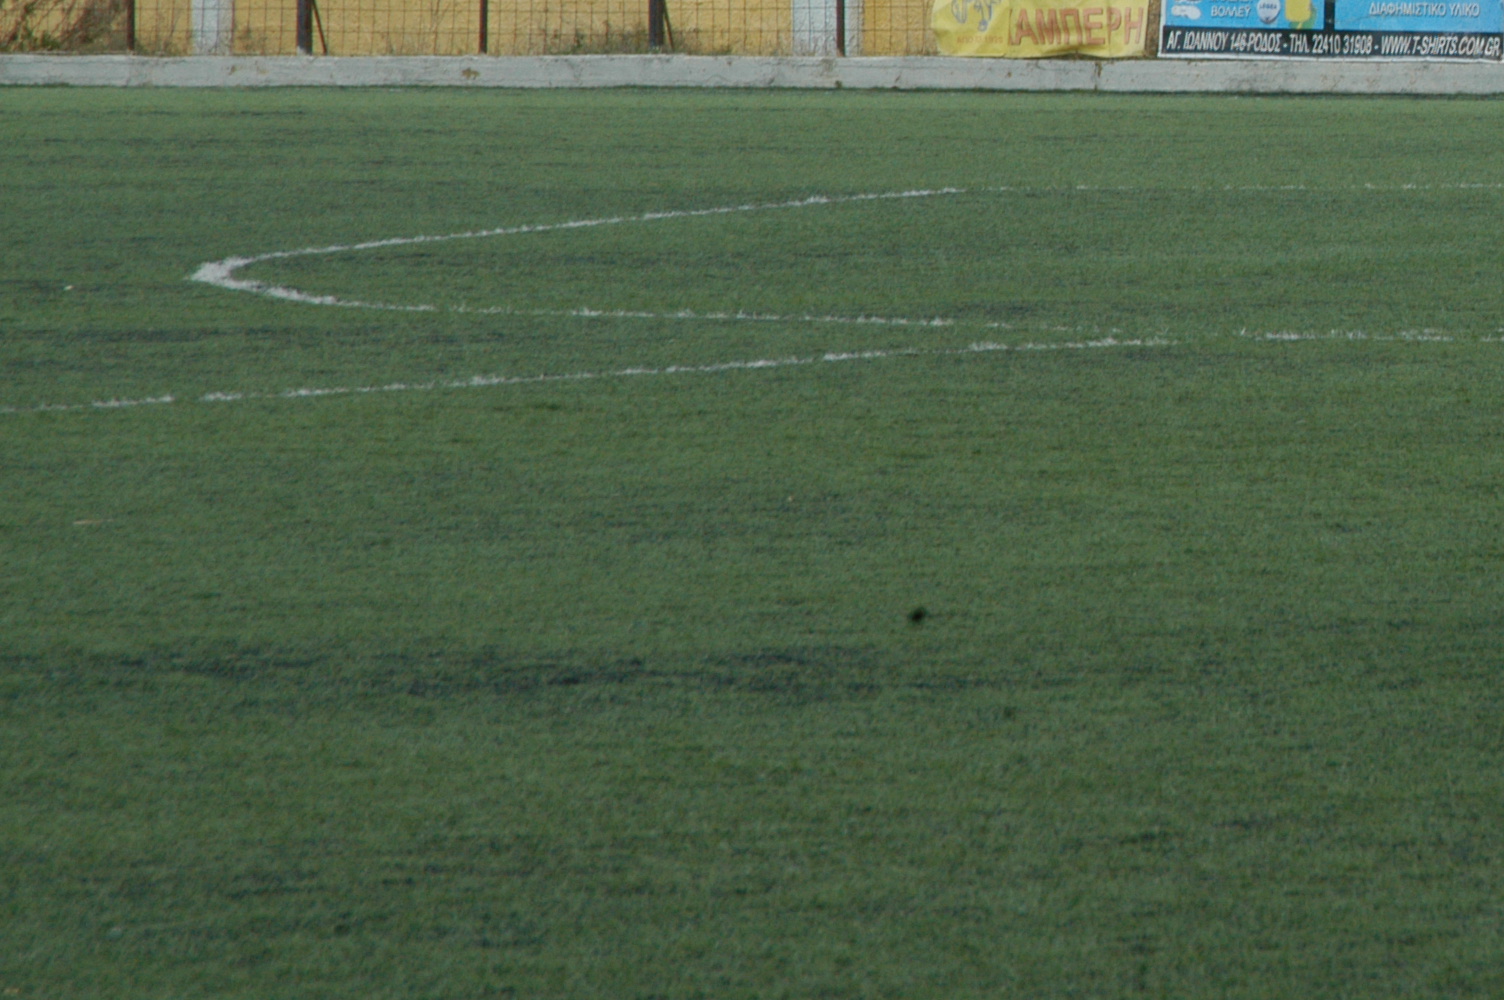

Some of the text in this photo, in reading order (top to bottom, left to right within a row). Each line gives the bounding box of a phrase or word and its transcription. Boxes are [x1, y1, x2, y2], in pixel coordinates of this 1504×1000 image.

[1369, 2, 1480, 16] ΔΙΑΦΗΜΙΣΤΙΚΟ ΥΛΙΚΟ
[1166, 31, 1181, 50] ΑΓ.
[1183, 31, 1230, 51] ΙΩΑΝΝΟΥ
[1312, 34, 1341, 54] 22410
